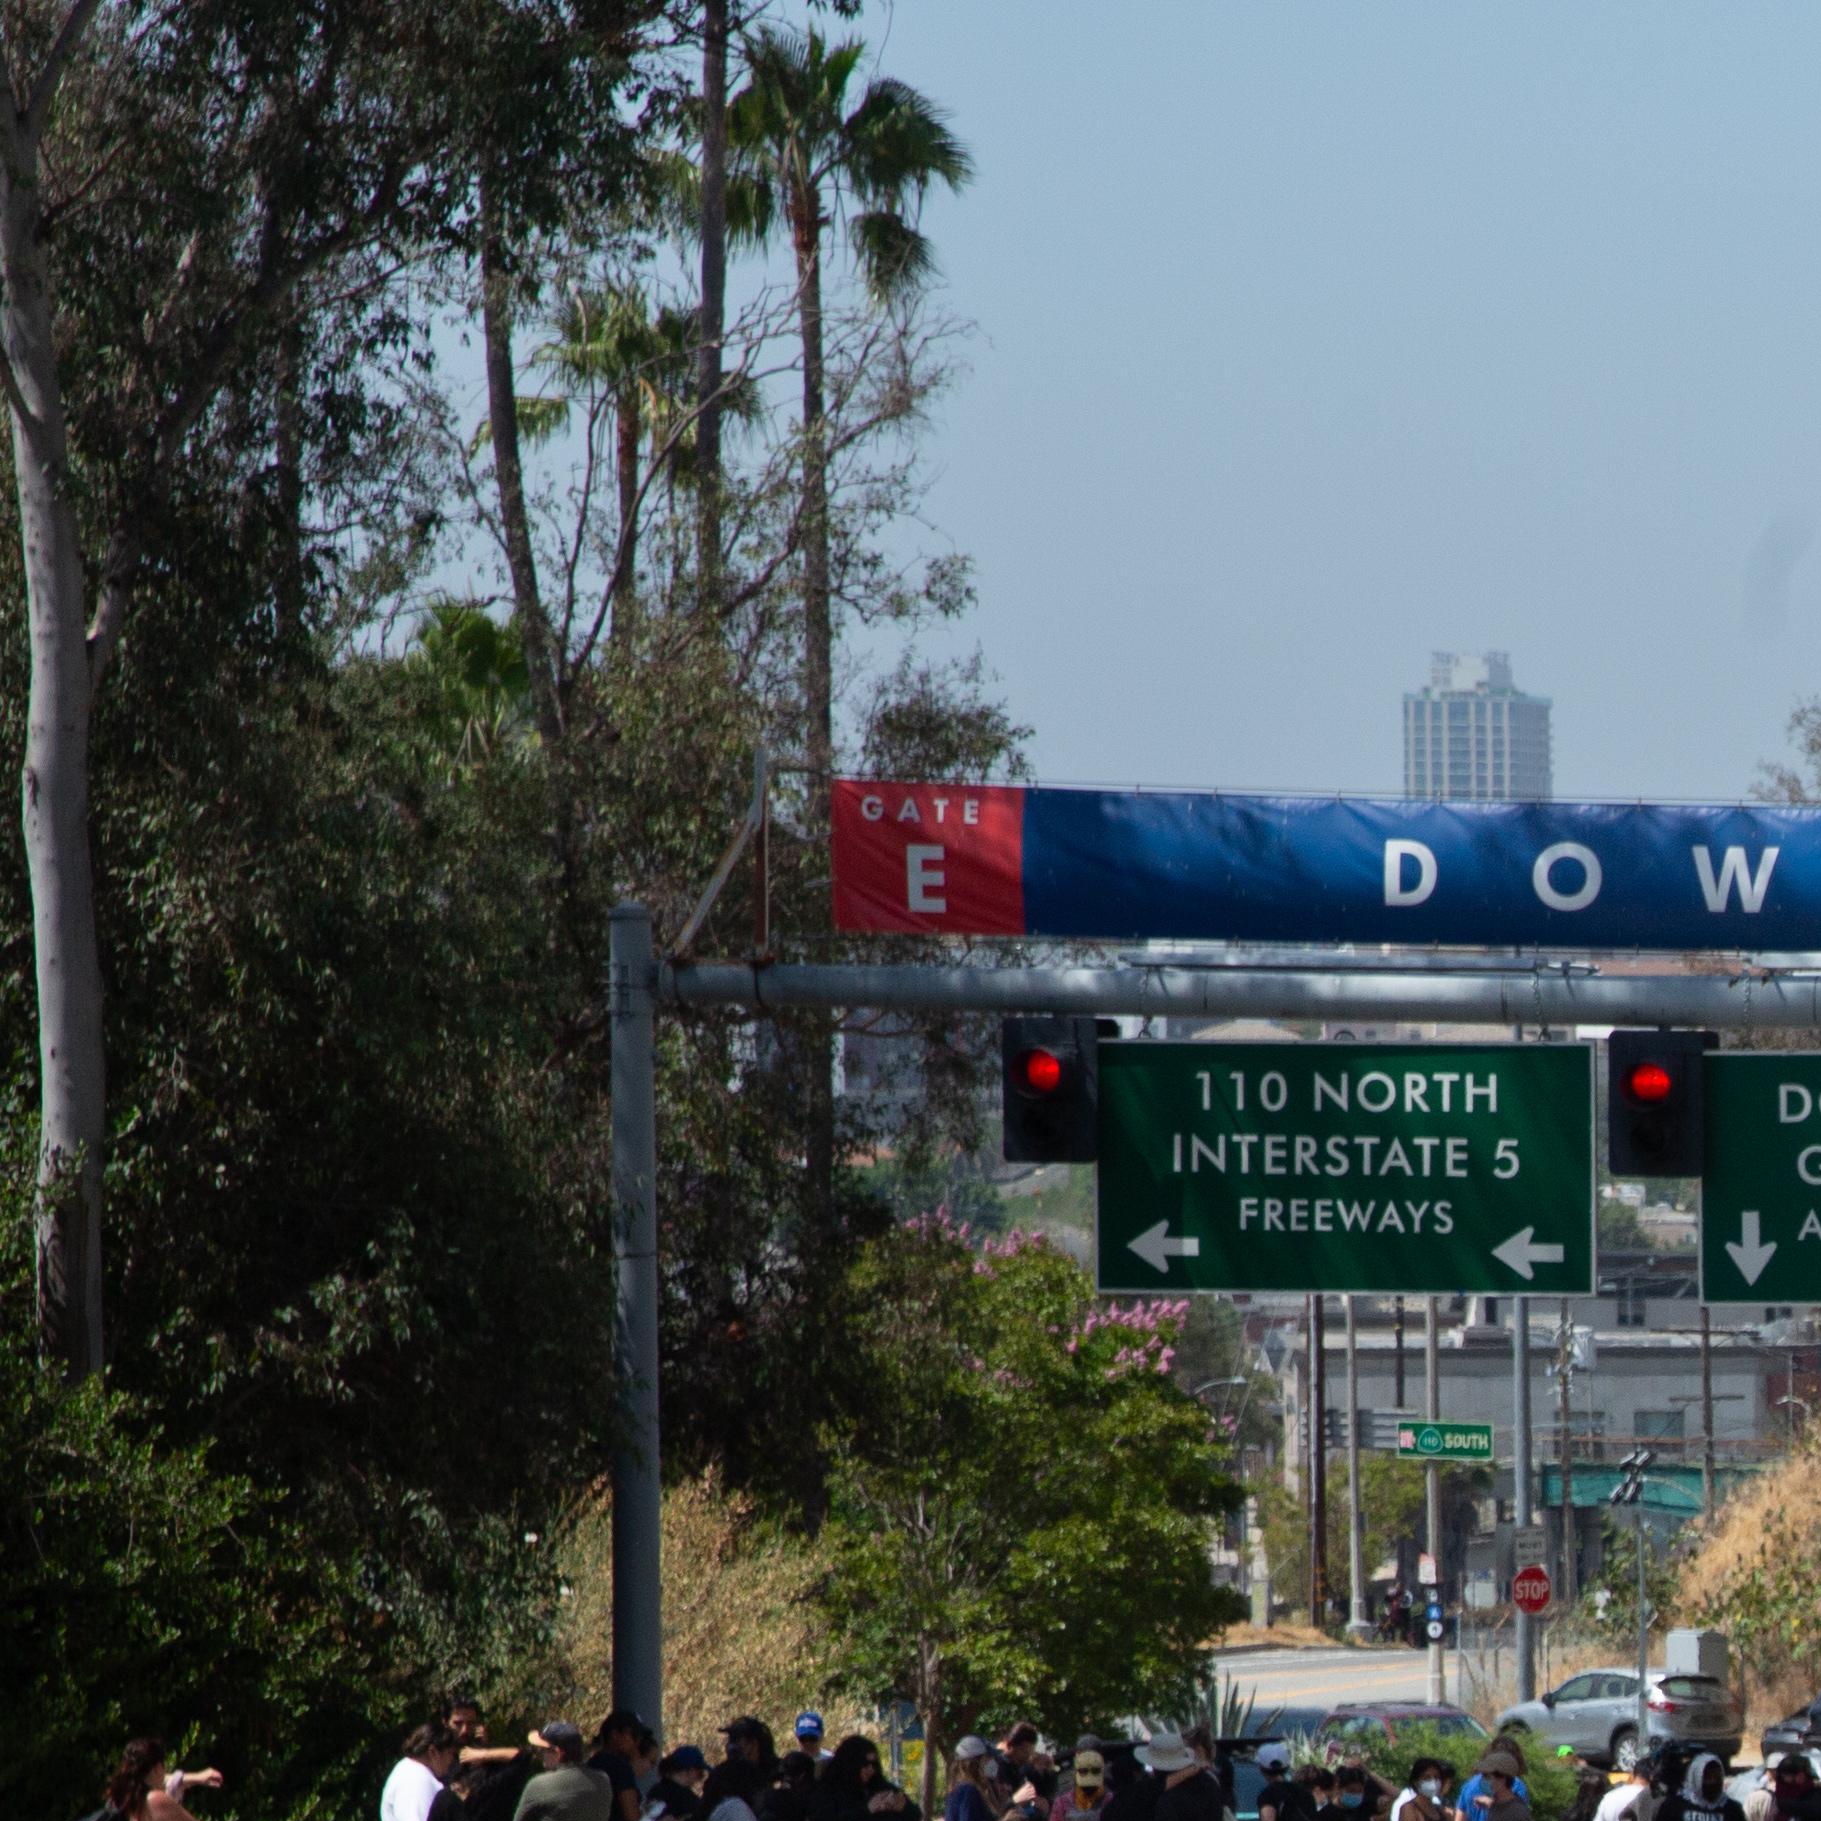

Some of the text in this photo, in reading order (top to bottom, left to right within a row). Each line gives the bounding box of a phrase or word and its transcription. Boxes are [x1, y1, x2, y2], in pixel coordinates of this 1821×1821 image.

[860, 795, 981, 826] GATE
[906, 843, 948, 914] E
[1195, 1070, 1499, 1114] 110 NORTH
[1171, 1132, 1521, 1181] INTERSTATE 5
[1238, 1197, 1455, 1237] FREEWAYS
[1444, 1432, 1489, 1450] SOUTH
[1515, 1580, 1549, 1600] STOP
